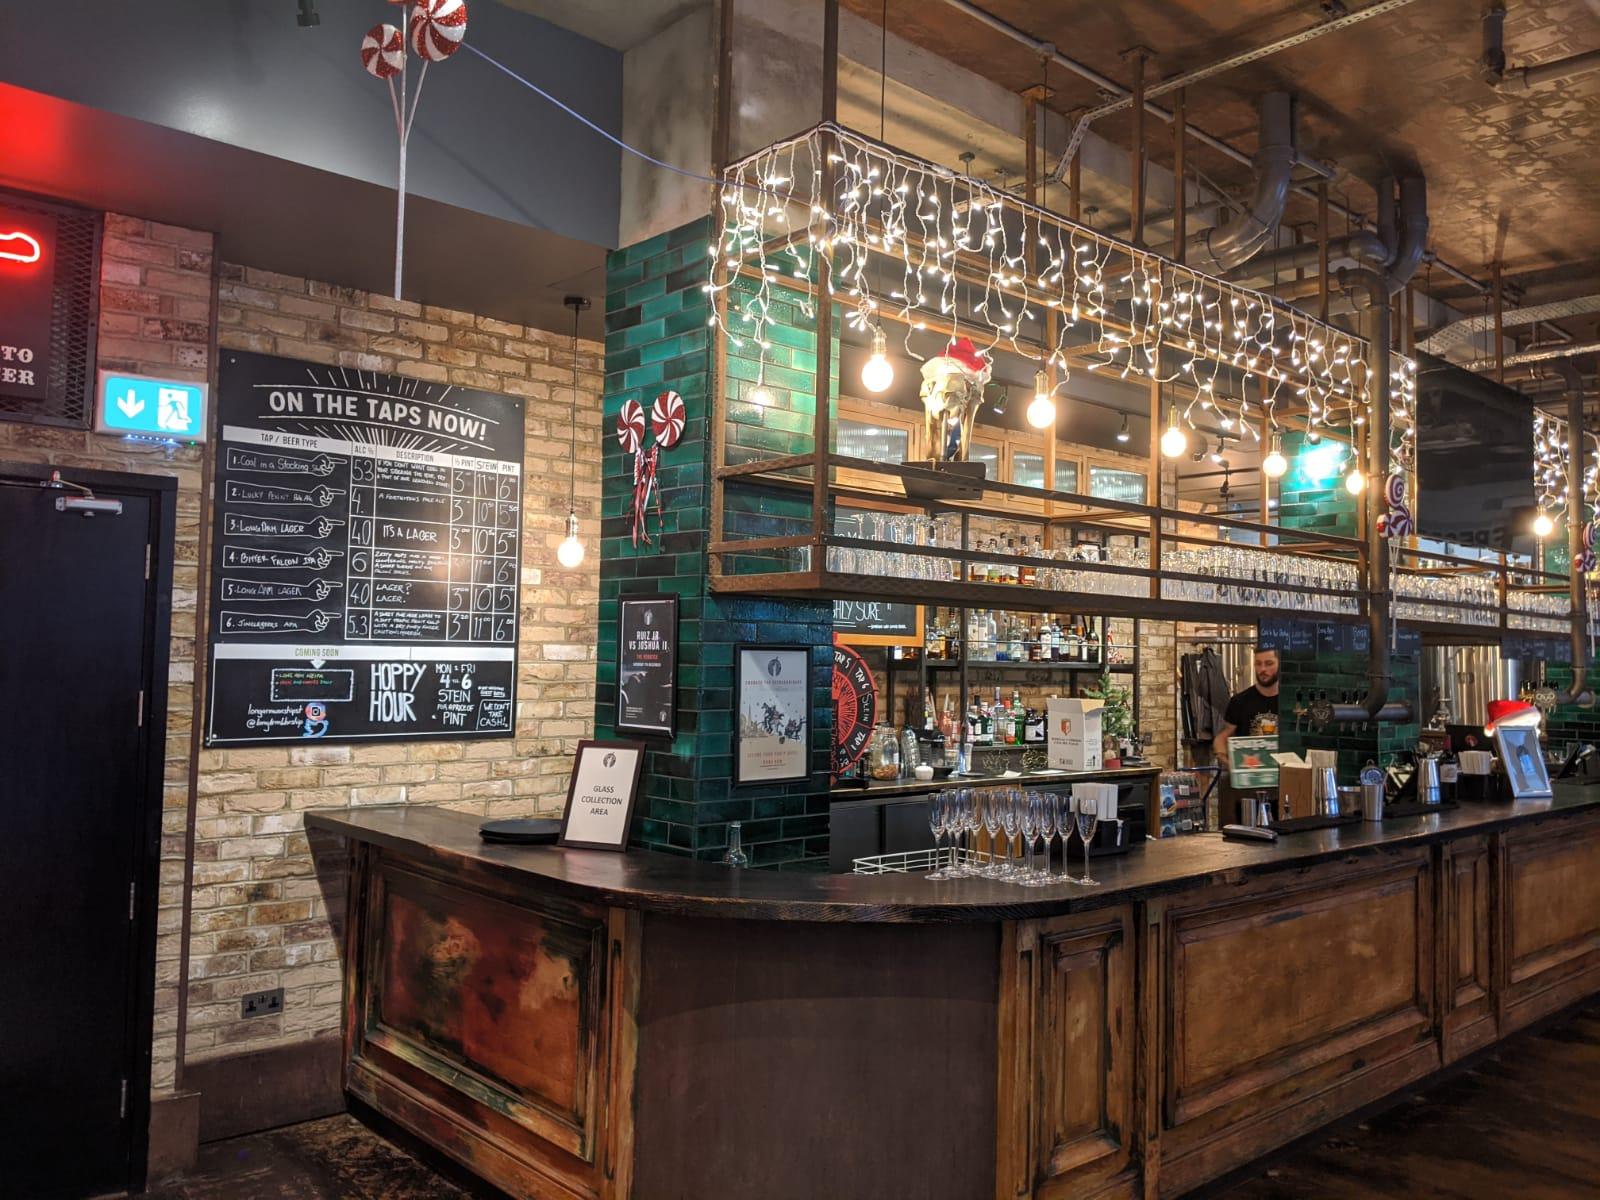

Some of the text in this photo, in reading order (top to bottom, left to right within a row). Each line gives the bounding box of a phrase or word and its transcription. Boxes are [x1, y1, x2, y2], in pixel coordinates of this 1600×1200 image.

[1, 345, 34, 363] TO
[0, 367, 35, 386] ER
[269, 391, 487, 441] ON THE TAPS NOW!
[261, 433, 274, 444] TAP
[283, 435, 300, 446] BEER
[302, 438, 318, 448] TYPE
[355, 445, 367, 455] ALC
[396, 449, 434, 463] DESCRIPTION
[277, 458, 309, 473] Stocking
[461, 459, 474, 468] PINT
[476, 459, 498, 471] STEIN
[502, 464, 515, 473] PINT
[453, 470, 465, 493] 3
[478, 473, 487, 496] 11
[500, 477, 510, 499] 6
[450, 499, 464, 523] 3
[478, 501, 488, 523] 10
[500, 503, 511, 525] 5
[280, 524, 304, 534] LAGER
[397, 527, 404, 538] A
[406, 530, 437, 543] LAGER
[451, 527, 461, 549] 3
[475, 528, 488, 554] 10
[496, 532, 509, 554] 5
[270, 555, 299, 566] FALCON
[352, 551, 367, 572] 6
[474, 559, 482, 582] 11
[497, 560, 509, 582] 6
[277, 586, 302, 596] LAGER
[376, 582, 412, 595] LAGER?
[376, 595, 406, 603] LAGER.
[450, 587, 462, 610] 3
[473, 587, 492, 611] 10
[494, 588, 511, 610] 5
[450, 613, 461, 639] 3
[474, 616, 482, 639] 11
[495, 618, 505, 640] 6
[636, 631, 650, 640] RUIZ
[295, 648, 339, 657] COMING SOON
[629, 641, 636, 650] VS
[637, 641, 660, 650] JOSHUA
[834, 651, 852, 668] TAP 5
[435, 663, 476, 674] MON FRI
[855, 667, 866, 682] TAP
[370, 662, 427, 692] HOPPY
[439, 674, 450, 689] 4
[461, 673, 472, 690] 6
[438, 689, 471, 703] STEIN
[369, 690, 417, 722] HOUR
[483, 702, 510, 711] WE DON'T
[443, 711, 467, 727] PINT
[855, 731, 866, 745] TAP
[593, 785, 614, 793] GLASS
[581, 795, 622, 805] COLLECTION
[590, 807, 608, 816] AREA
